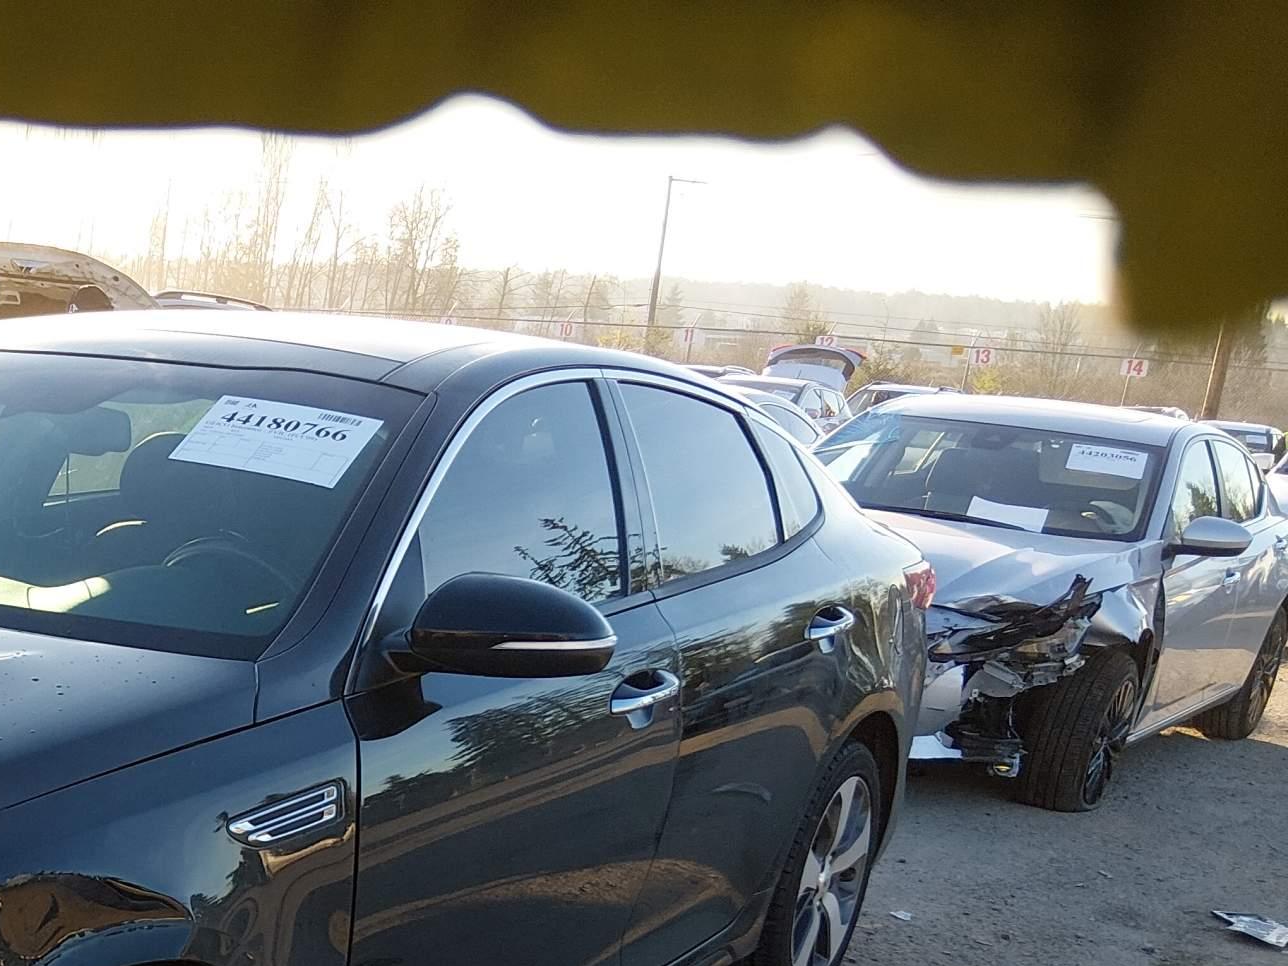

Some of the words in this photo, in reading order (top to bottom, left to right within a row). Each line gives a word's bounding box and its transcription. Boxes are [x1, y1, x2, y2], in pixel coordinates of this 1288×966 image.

[557, 323, 573, 337] 10
[684, 329, 695, 343] 11
[975, 350, 991, 364] 13
[1127, 360, 1144, 376] 14
[220, 411, 352, 442] 44180766
